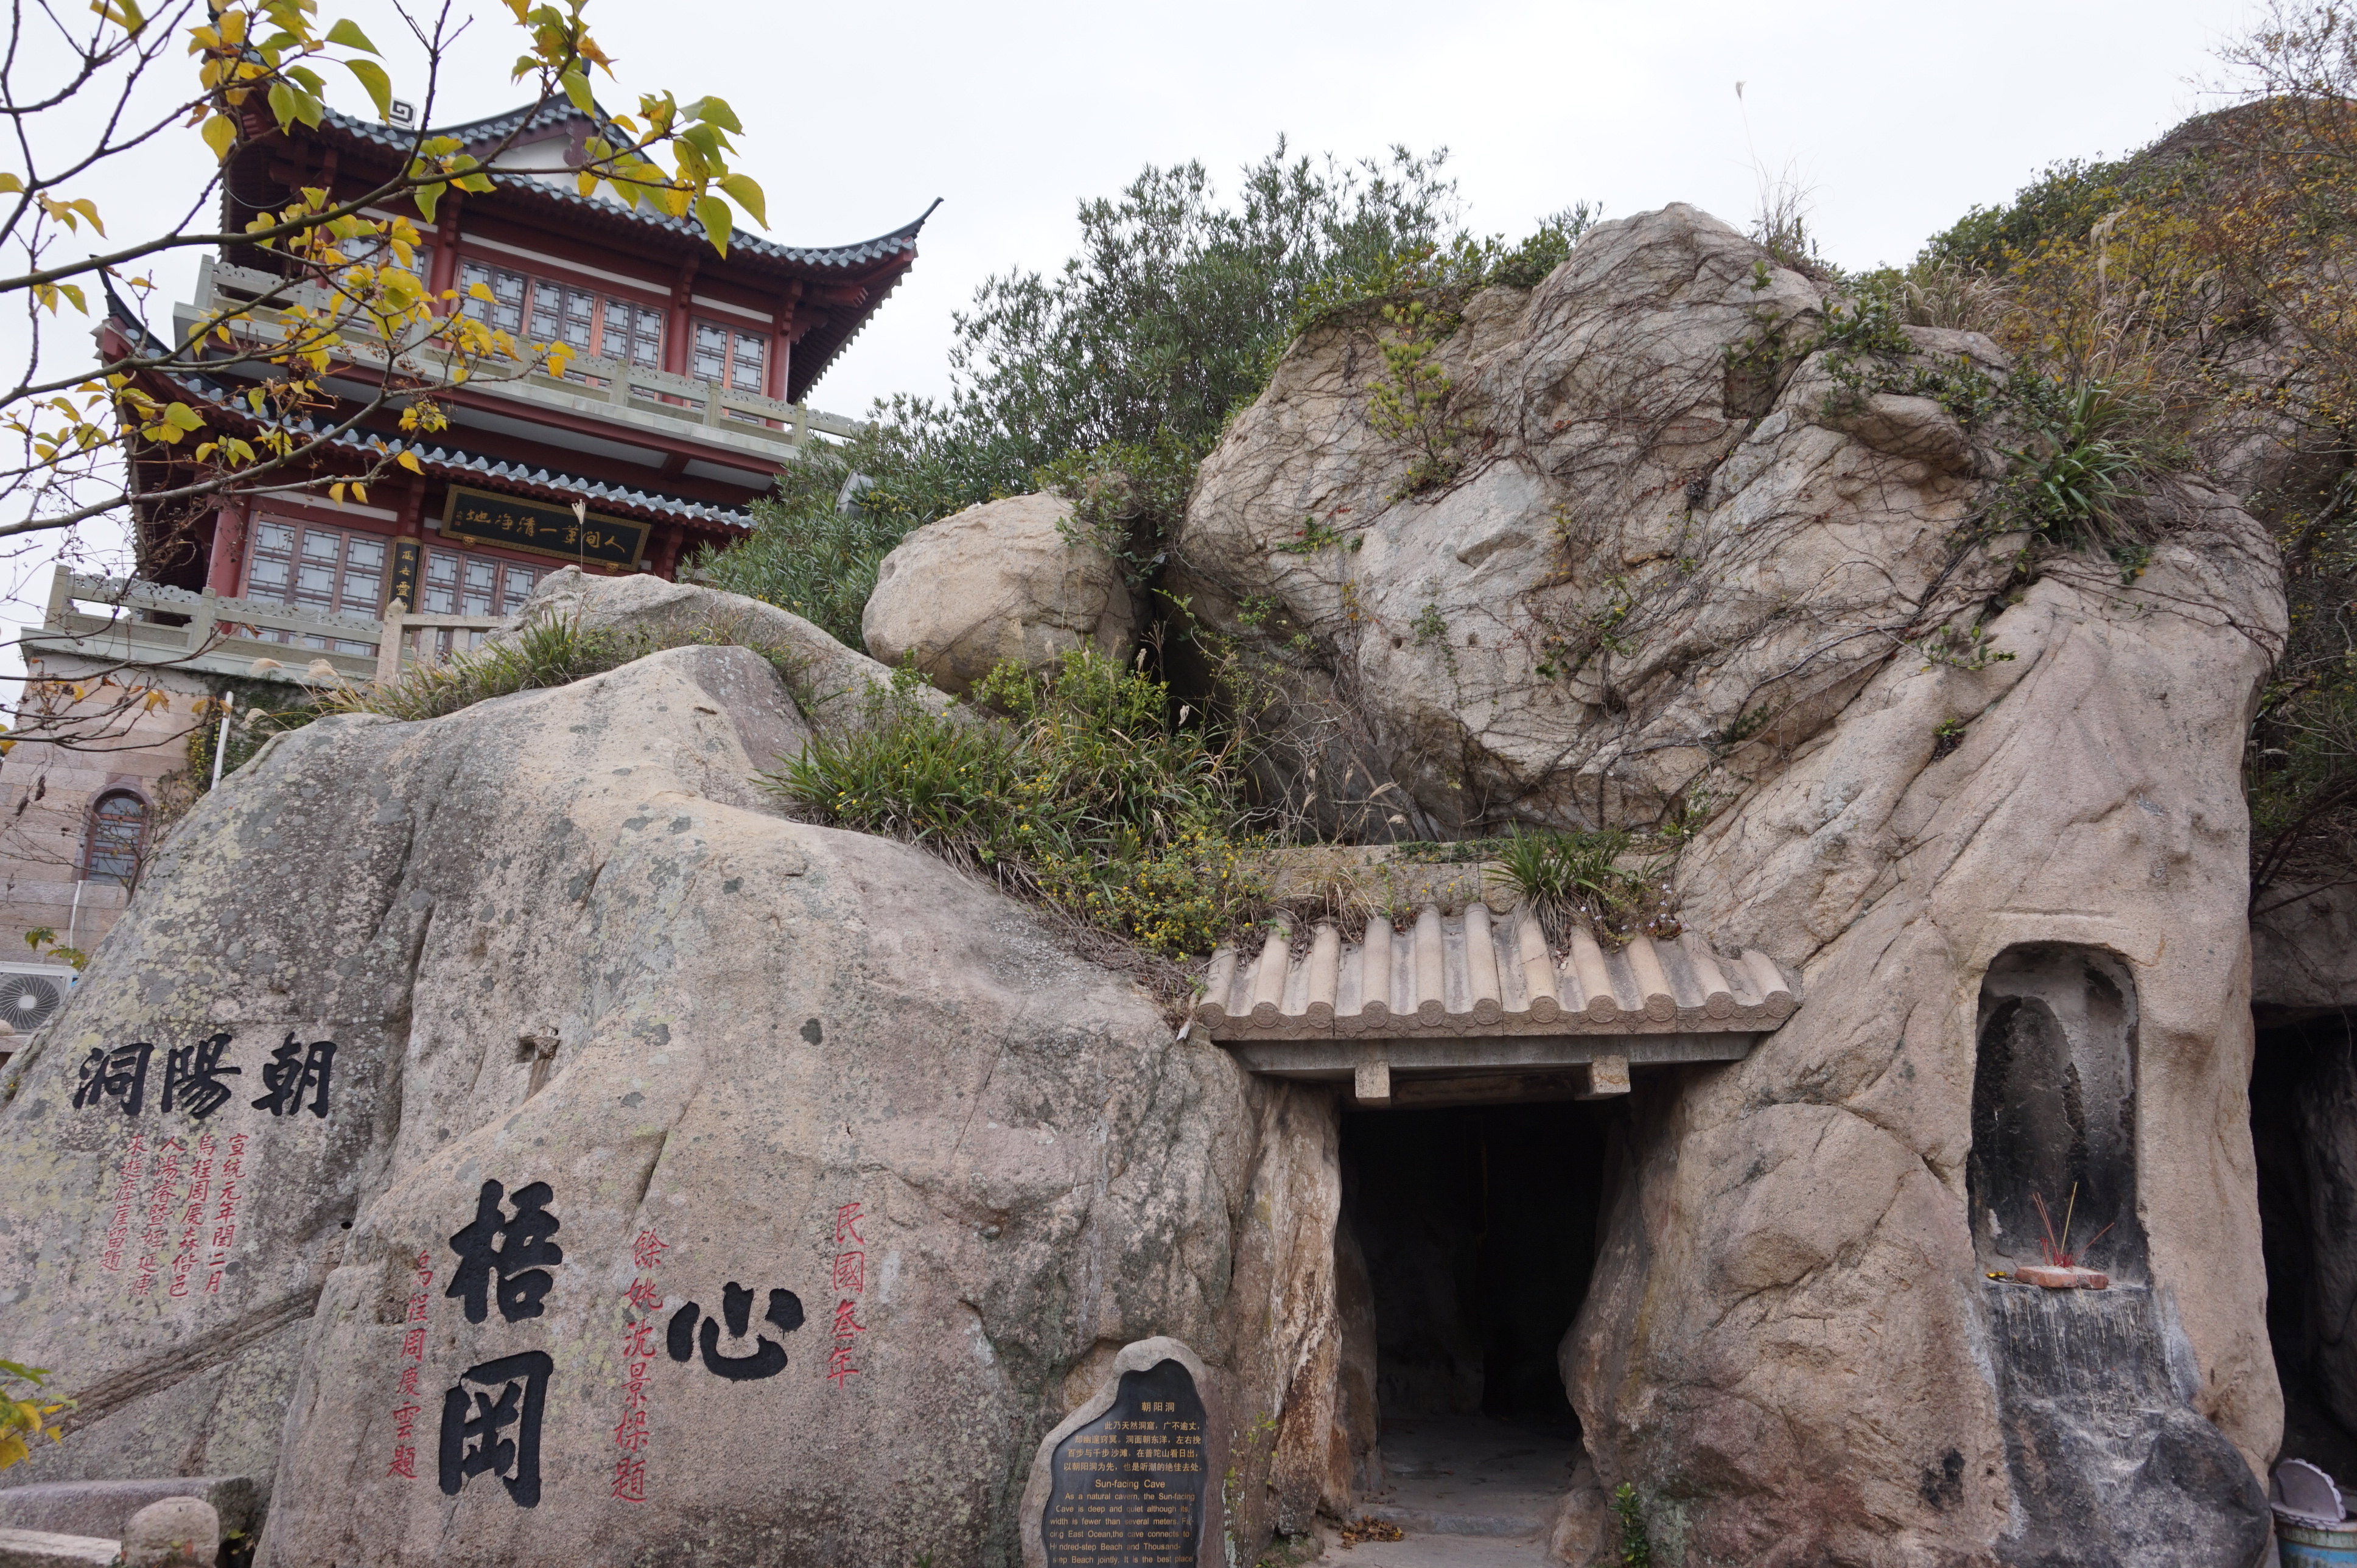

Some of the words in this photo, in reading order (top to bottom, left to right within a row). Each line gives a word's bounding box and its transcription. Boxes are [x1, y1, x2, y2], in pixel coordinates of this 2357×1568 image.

[396, 550, 414, 609] 西去靈
[72, 1032, 338, 1120] 朝陽洞
[203, 1133, 249, 1293] 宣統元年閏二月
[666, 1281, 806, 1382] 心
[386, 1250, 433, 1480] 烏程周慶雲題
[1141, 1402, 1175, 1412] 朝阳洞
[1095, 1479, 1139, 1489] Sun-facing
[1144, 1479, 1166, 1488] Cave
[1158, 1493, 1195, 1502] Sun-facing
[1088, 1505, 1105, 1514] deep
[1126, 1505, 1143, 1514] quiet
[1147, 1505, 1176, 1514] although
[1174, 1556, 1193, 1564] place
